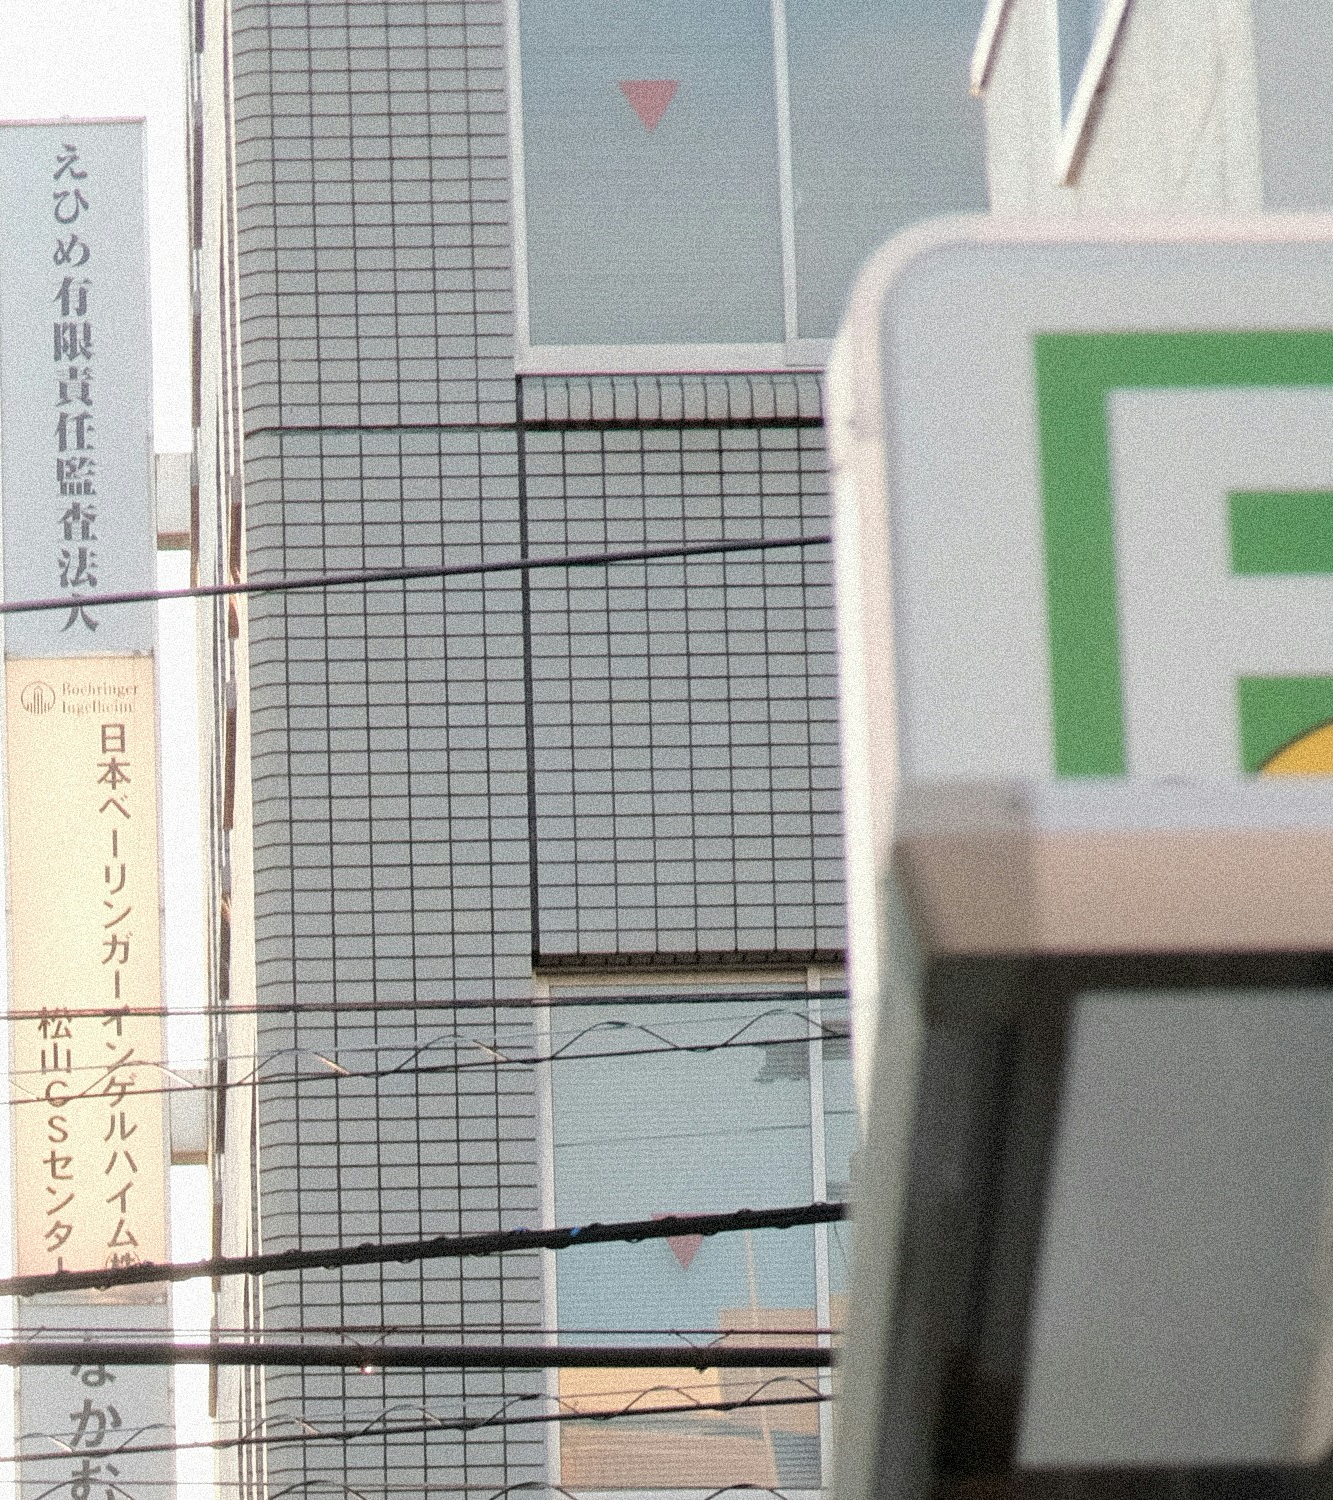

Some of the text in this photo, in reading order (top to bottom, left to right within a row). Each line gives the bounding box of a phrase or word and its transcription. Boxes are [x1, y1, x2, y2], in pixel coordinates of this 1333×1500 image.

[52, 143, 98, 633] えひめ有限責任監査法人
[62, 681, 139, 698] Boehringer
[62, 700, 134, 715] Ingelheim
